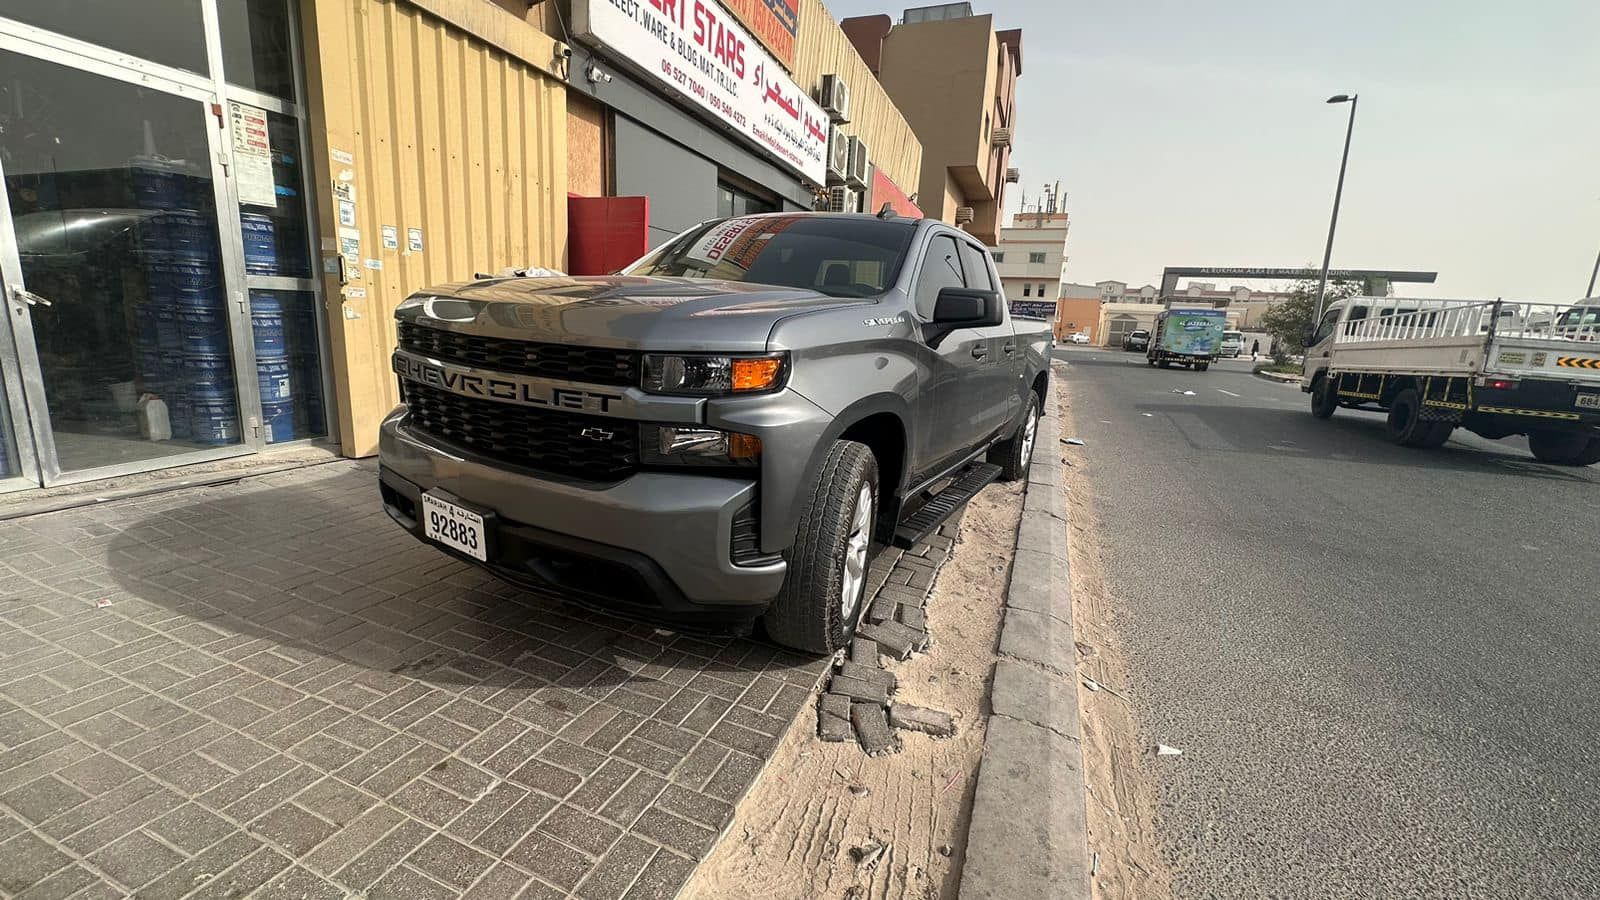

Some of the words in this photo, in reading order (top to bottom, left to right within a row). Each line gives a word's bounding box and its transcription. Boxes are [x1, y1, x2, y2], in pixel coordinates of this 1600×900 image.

[670, 31, 676, 51] &
[693, 0, 745, 80] STARS
[661, 58, 672, 76] 06
[673, 66, 688, 86] 527
[688, 77, 705, 99] 7040
[709, 92, 721, 110] 050
[733, 110, 747, 128] 4272
[392, 355, 623, 413] CHEVROLET
[431, 510, 478, 550] 92883
